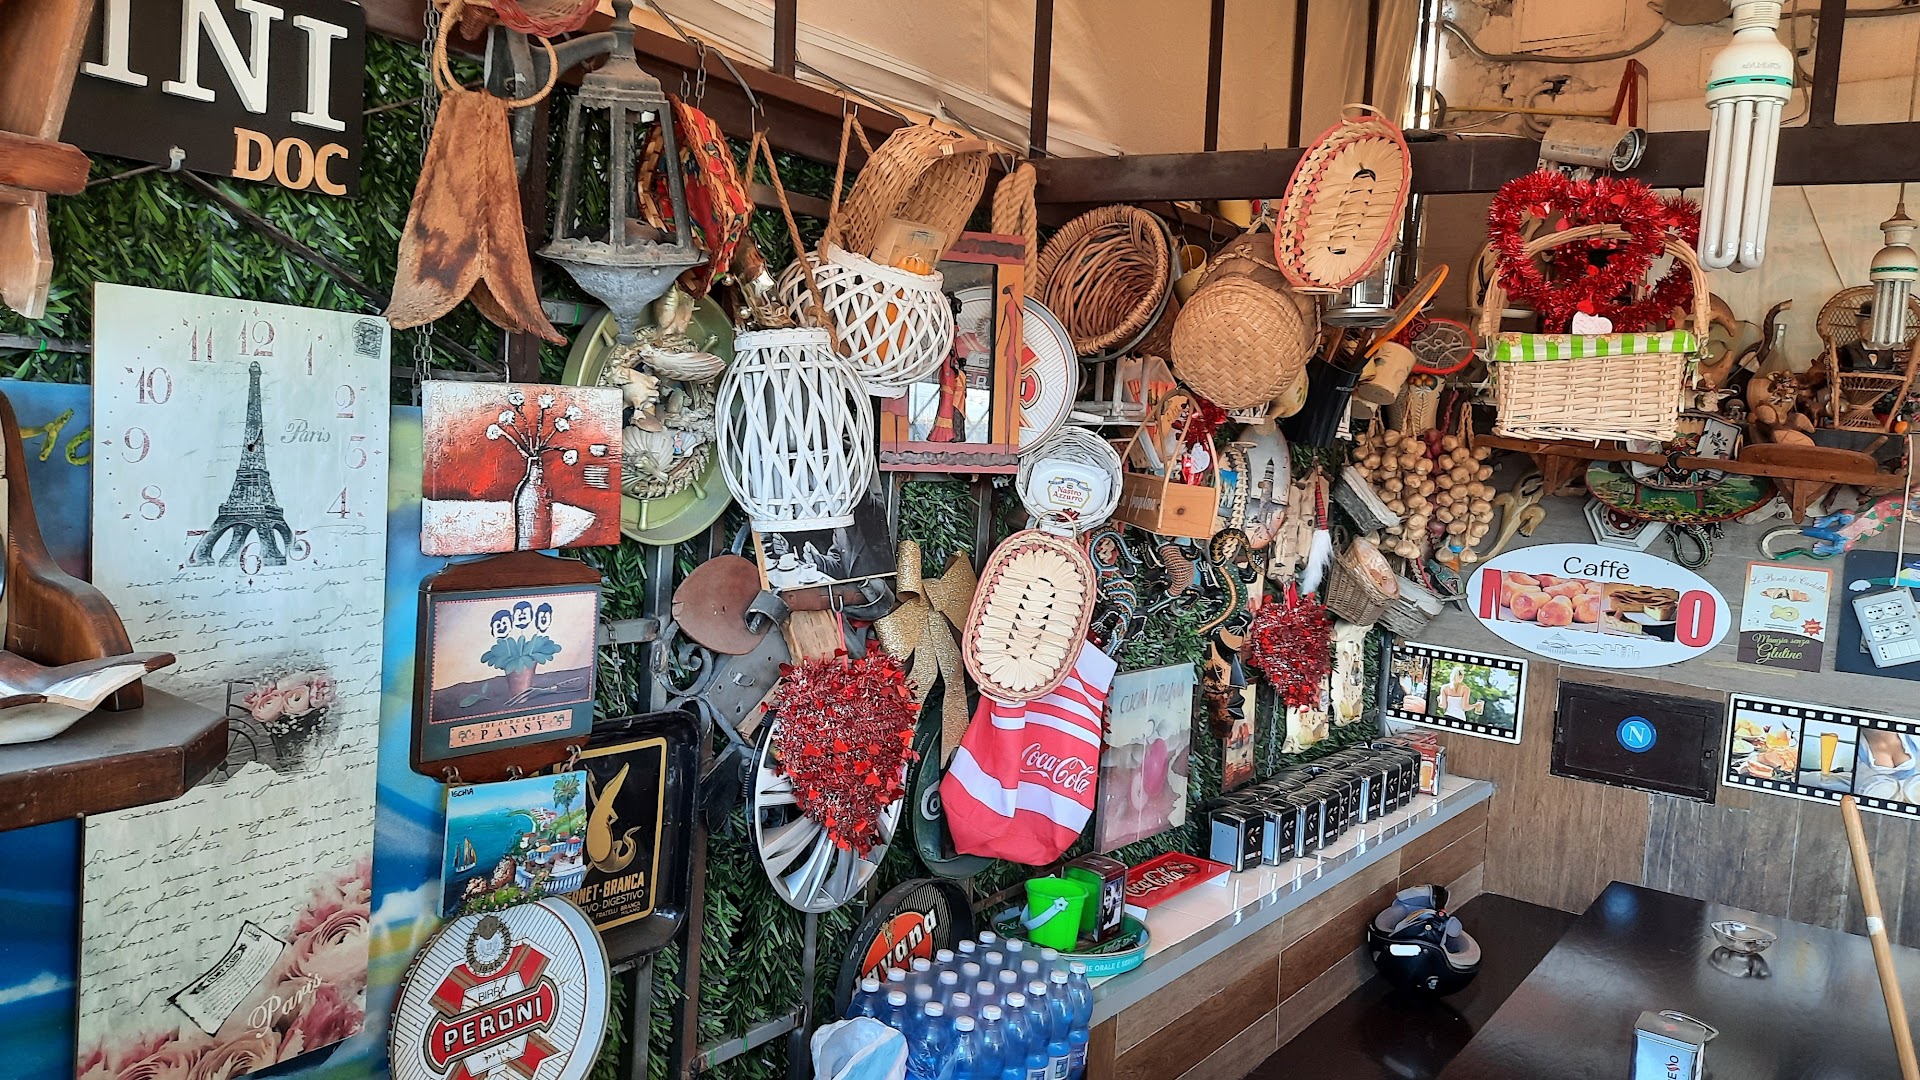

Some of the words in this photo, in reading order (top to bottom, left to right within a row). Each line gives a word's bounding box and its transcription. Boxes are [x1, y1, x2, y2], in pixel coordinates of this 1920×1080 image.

[231, 126, 349, 196] DOC
[188, 325, 217, 363] 11
[238, 319, 276, 358] 12
[305, 341, 314, 376] 1
[135, 366, 173, 405] 10
[335, 384, 356, 419] 2
[121, 427, 151, 464] 9
[280, 417, 332, 445] Paris
[345, 436, 368, 470] 3
[139, 485, 166, 521] 8
[326, 486, 352, 519] 4
[1052, 491, 1083, 503] Azzurro
[1057, 486, 1082, 497] Nastro
[239, 542, 262, 576] 6
[288, 530, 312, 562] 5
[1563, 556, 1631, 580] Caffè
[1789, 637, 1811, 648] senza
[480, 720, 546, 741] PANSY
[1628, 725, 1646, 743] N
[451, 786, 474, 799] ISCHIA
[1094, 961, 1116, 972] ORALE
[247, 971, 324, 1039] Paris
[478, 984, 508, 1002] BIRRA
[443, 996, 544, 1053] PERONI
